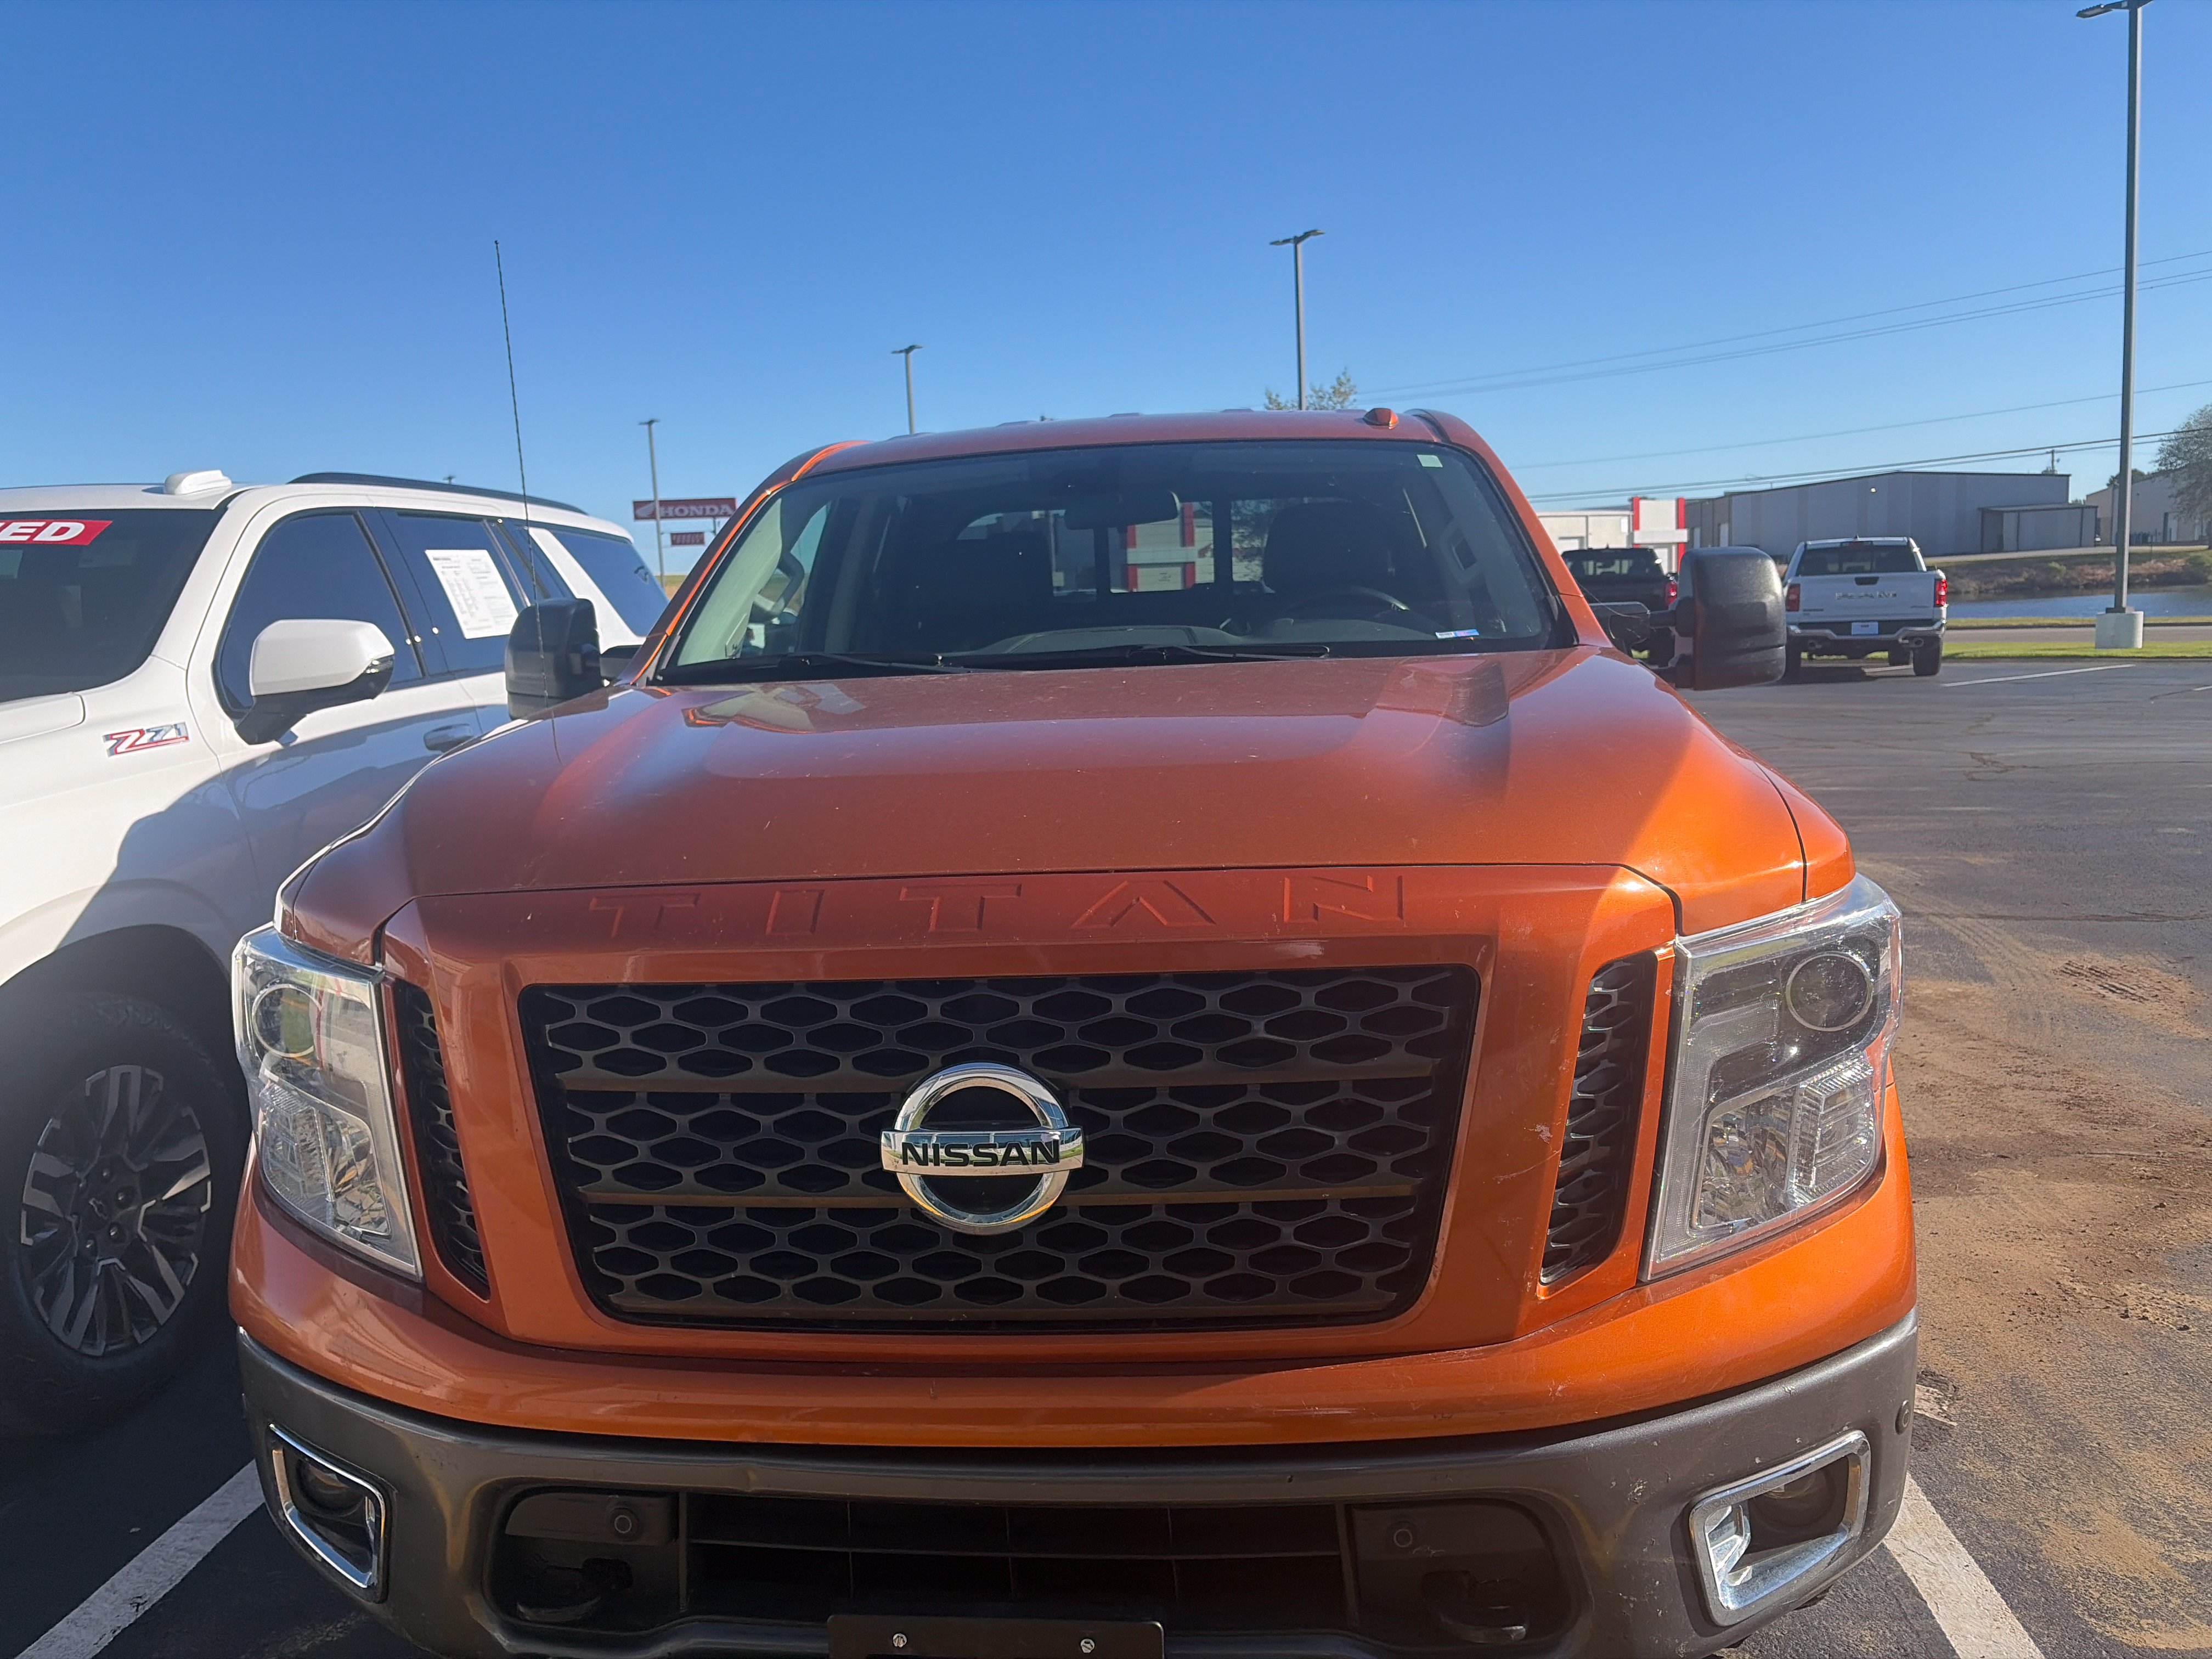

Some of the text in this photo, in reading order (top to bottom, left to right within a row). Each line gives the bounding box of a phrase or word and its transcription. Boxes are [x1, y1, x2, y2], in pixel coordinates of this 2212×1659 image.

[659, 504, 733, 517] HONDA
[0, 522, 85, 541] ED
[102, 721, 189, 757] Z71
[589, 874, 1404, 938] TITAN
[901, 1141, 1061, 1167] NISSAN
